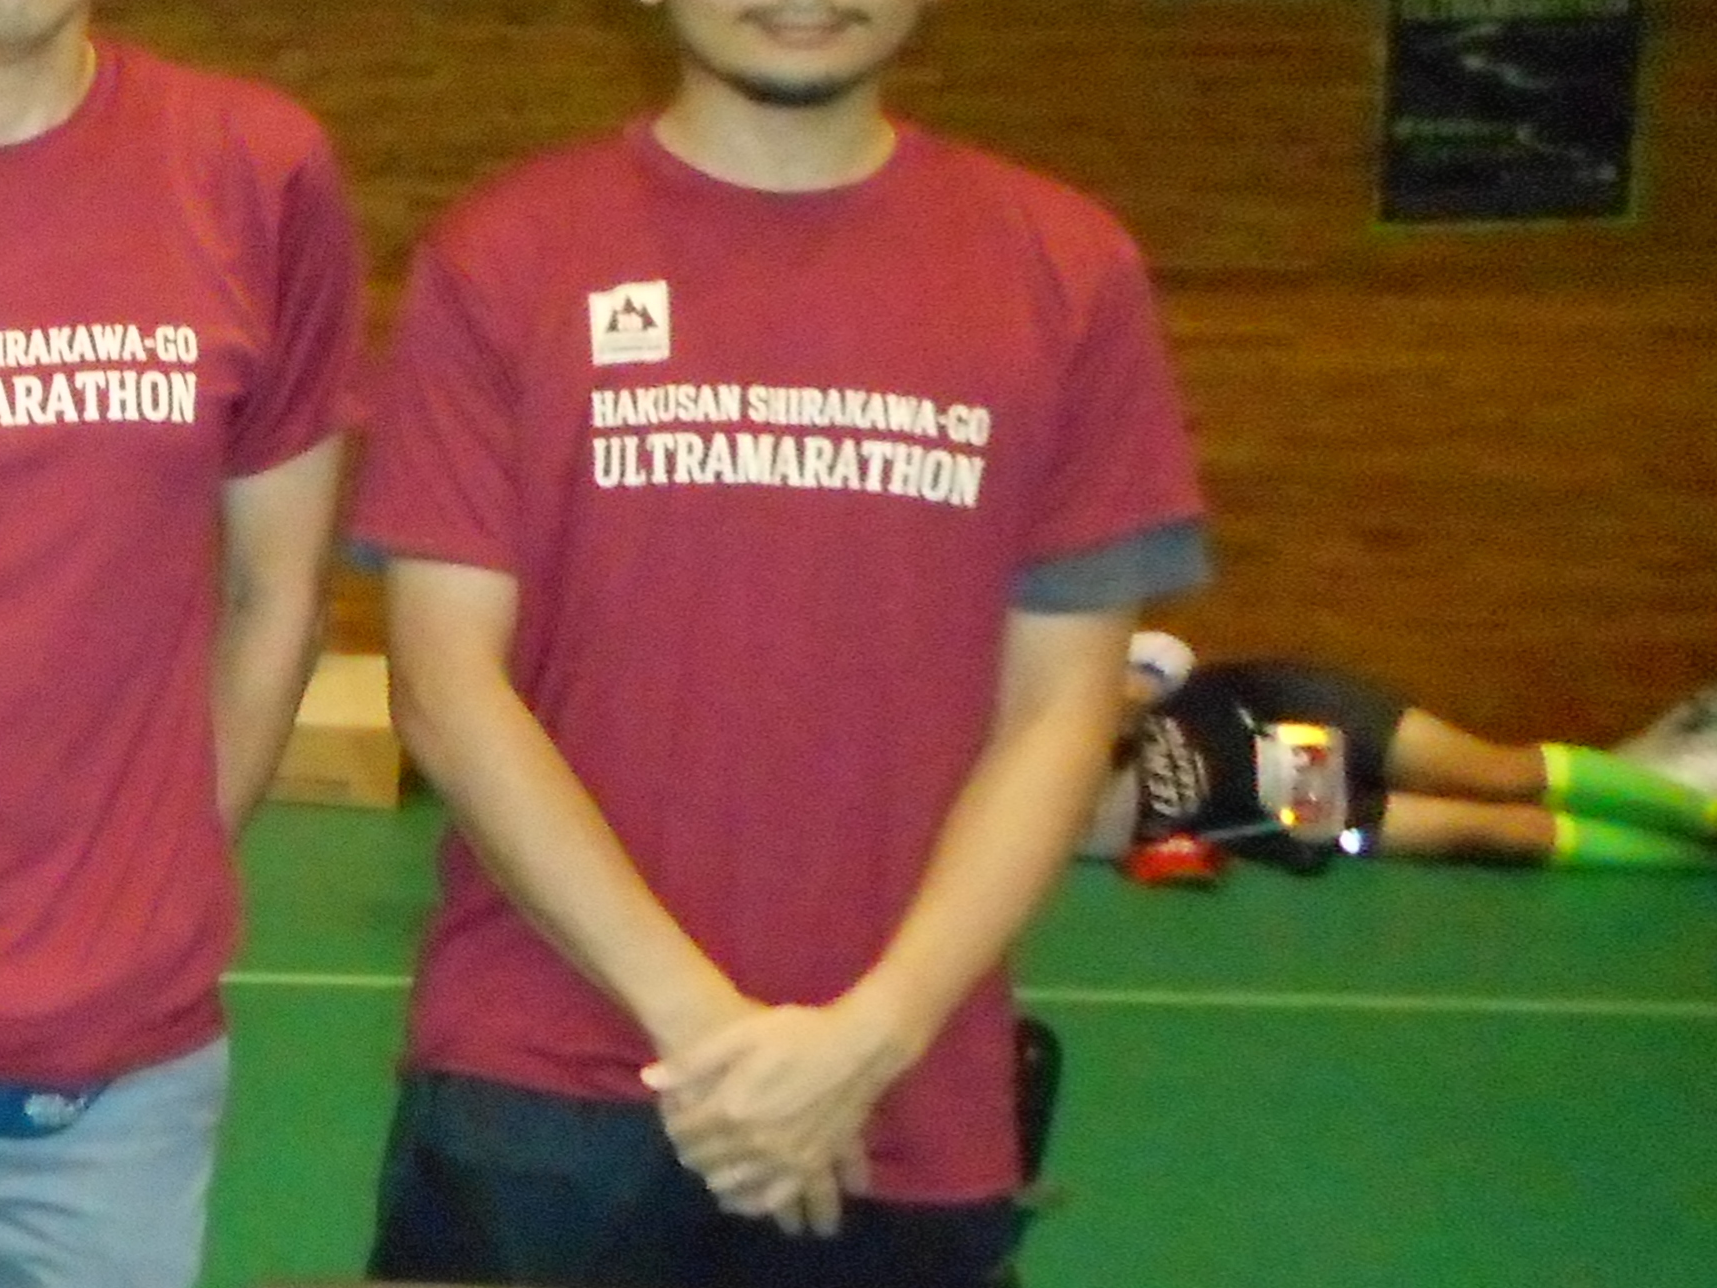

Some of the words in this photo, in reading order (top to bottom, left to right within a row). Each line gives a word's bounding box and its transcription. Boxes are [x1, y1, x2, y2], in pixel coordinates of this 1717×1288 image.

[592, 384, 741, 428] HAKUSAN
[748, 385, 990, 447] SHIRAKAWA-GO
[592, 431, 985, 509] ULTRAMARATHON
